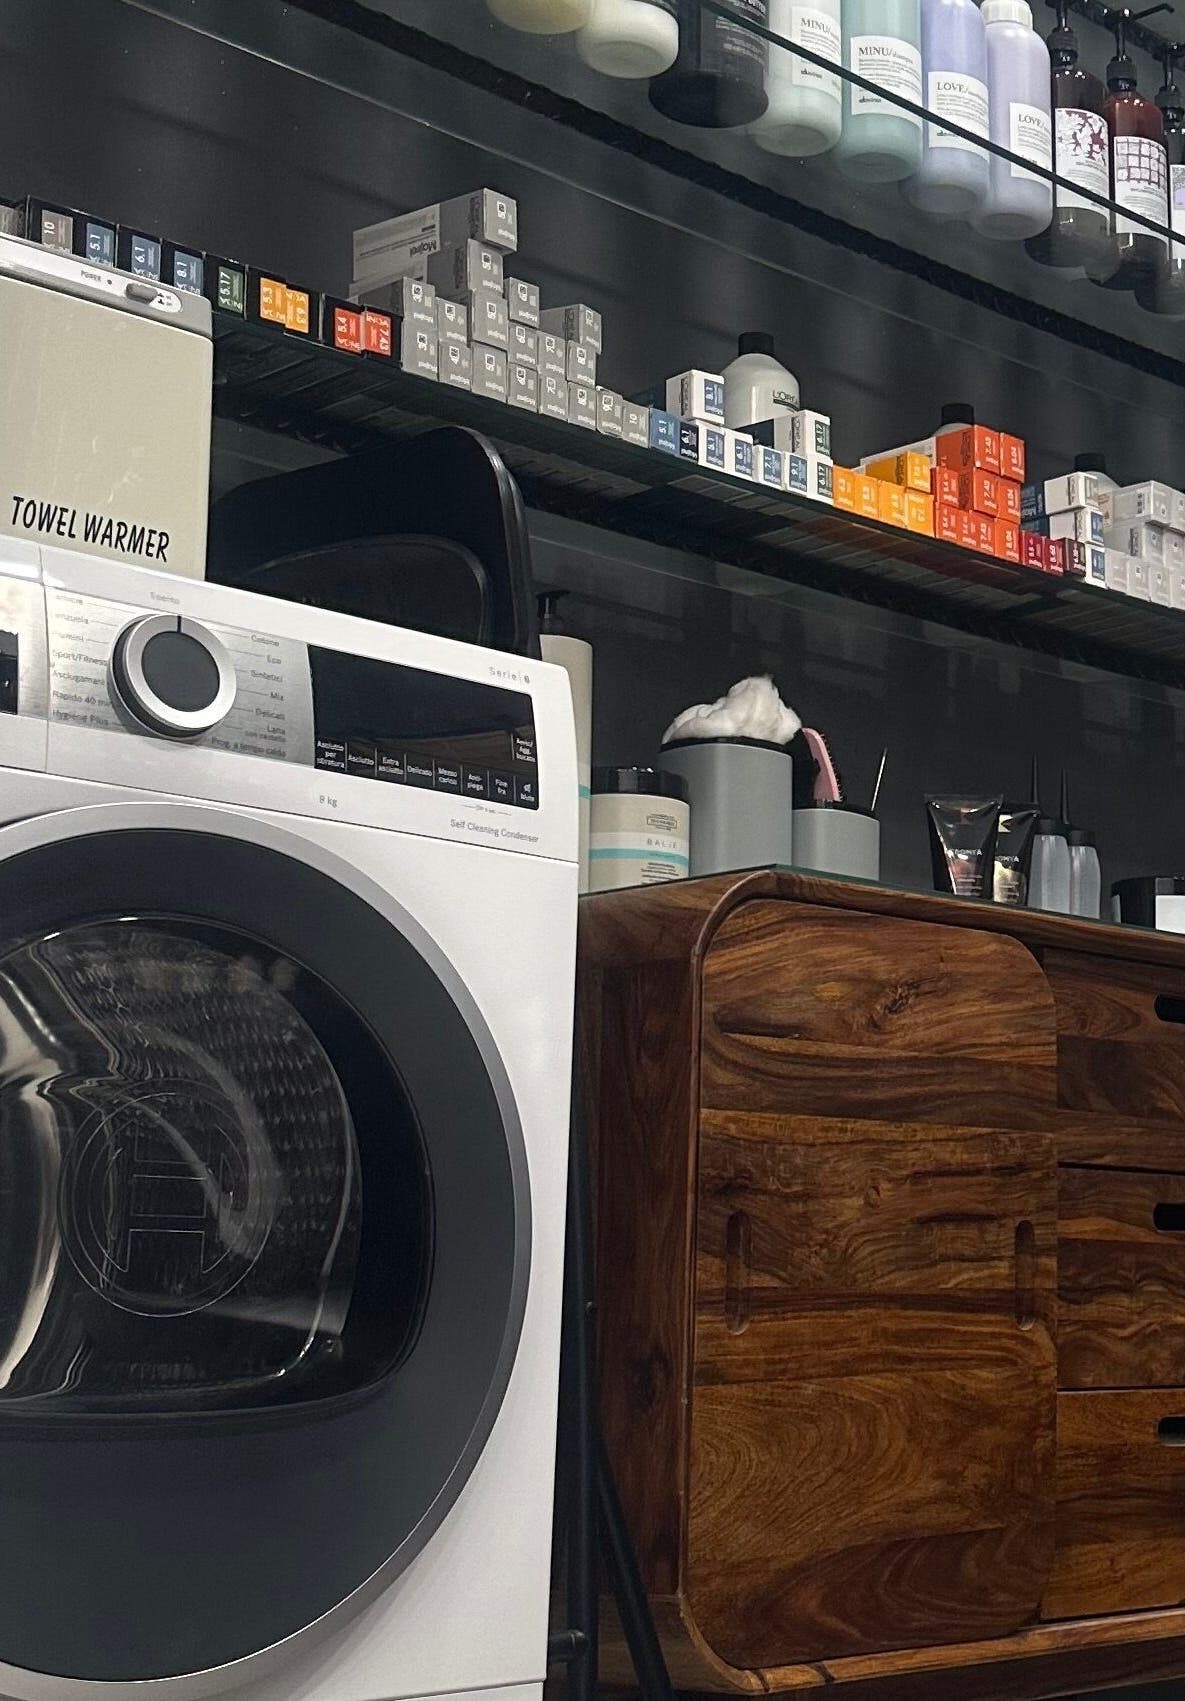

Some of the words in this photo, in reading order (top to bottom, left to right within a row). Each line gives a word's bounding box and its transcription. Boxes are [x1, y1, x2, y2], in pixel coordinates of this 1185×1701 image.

[12, 496, 77, 539] TOWEL
[84, 512, 170, 563] WARMER
[450, 818, 466, 829] Self
[467, 822, 500, 838] Cleaning
[501, 828, 539, 843] Condenser
